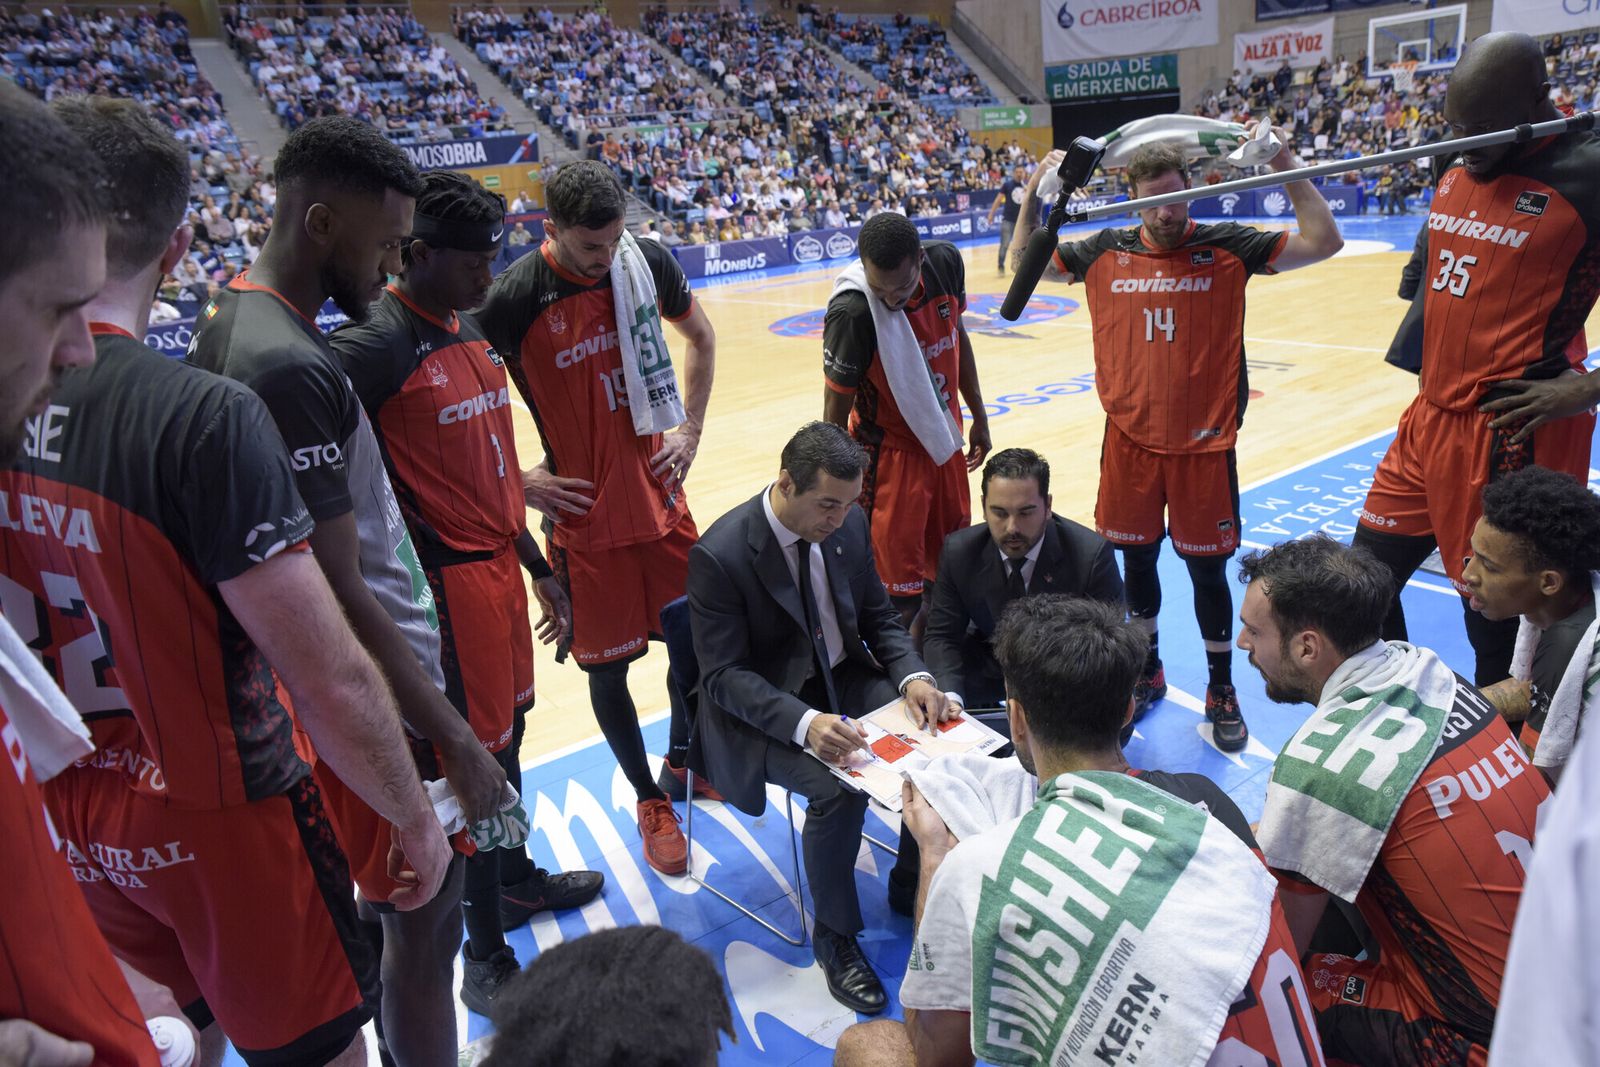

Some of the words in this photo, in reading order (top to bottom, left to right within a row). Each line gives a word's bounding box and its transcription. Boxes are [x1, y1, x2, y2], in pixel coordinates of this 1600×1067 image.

[1244, 41, 1278, 61] ALZA
[1282, 40, 1291, 56] A
[1295, 34, 1323, 54] VOZ
[1128, 57, 1153, 73] DE
[1053, 74, 1169, 100] EMERXENCIA
[1428, 210, 1530, 248] COVIRAN
[1110, 270, 1213, 294] COVIRAN
[1432, 248, 1478, 297] 35
[1143, 307, 1176, 342] 14
[648, 382, 677, 403] ERN
[289, 441, 344, 471] STO
[1106, 530, 1136, 542] asisa
[1181, 543, 1219, 552] BERNER
[604, 640, 636, 658] asisa
[985, 772, 1166, 1062] FINISHER
[1066, 996, 1104, 1057] NUTRICIÓN
[1093, 937, 1137, 1002] DEPORTIVA
[1346, 976, 1357, 994] acb
[1093, 972, 1157, 1067] KERN
